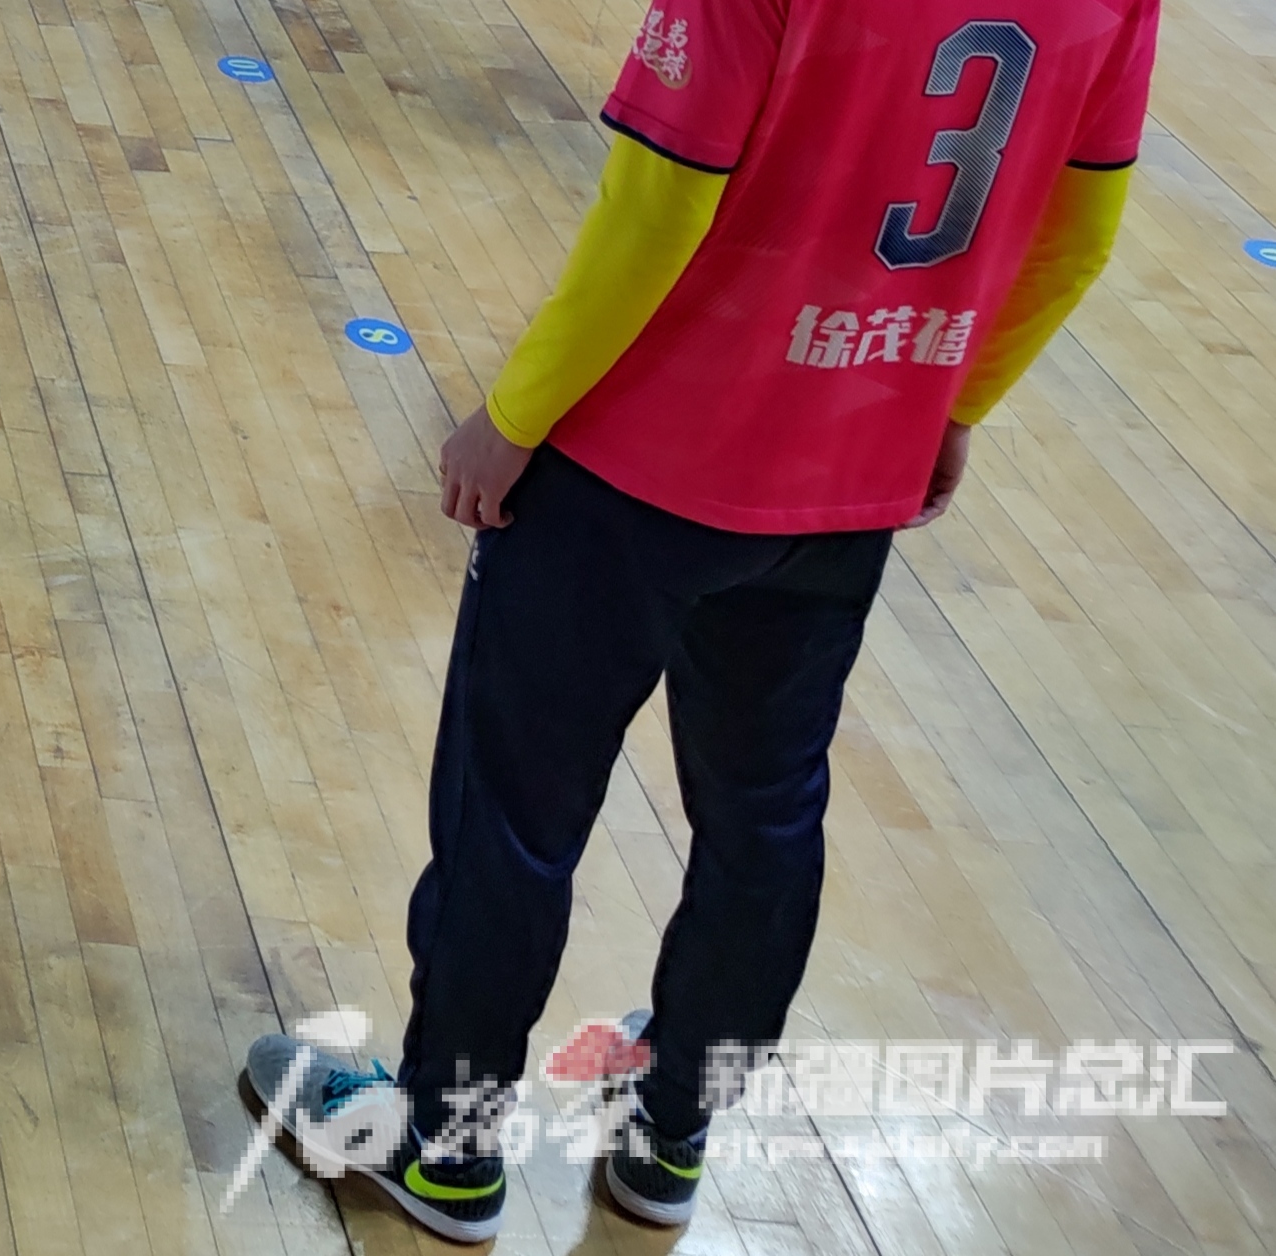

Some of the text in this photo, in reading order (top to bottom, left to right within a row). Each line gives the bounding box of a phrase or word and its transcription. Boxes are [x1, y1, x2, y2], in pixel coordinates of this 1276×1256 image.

[227, 59, 265, 80] 10
[874, 20, 1037, 271] 3
[786, 304, 977, 369] 徐茂禧
